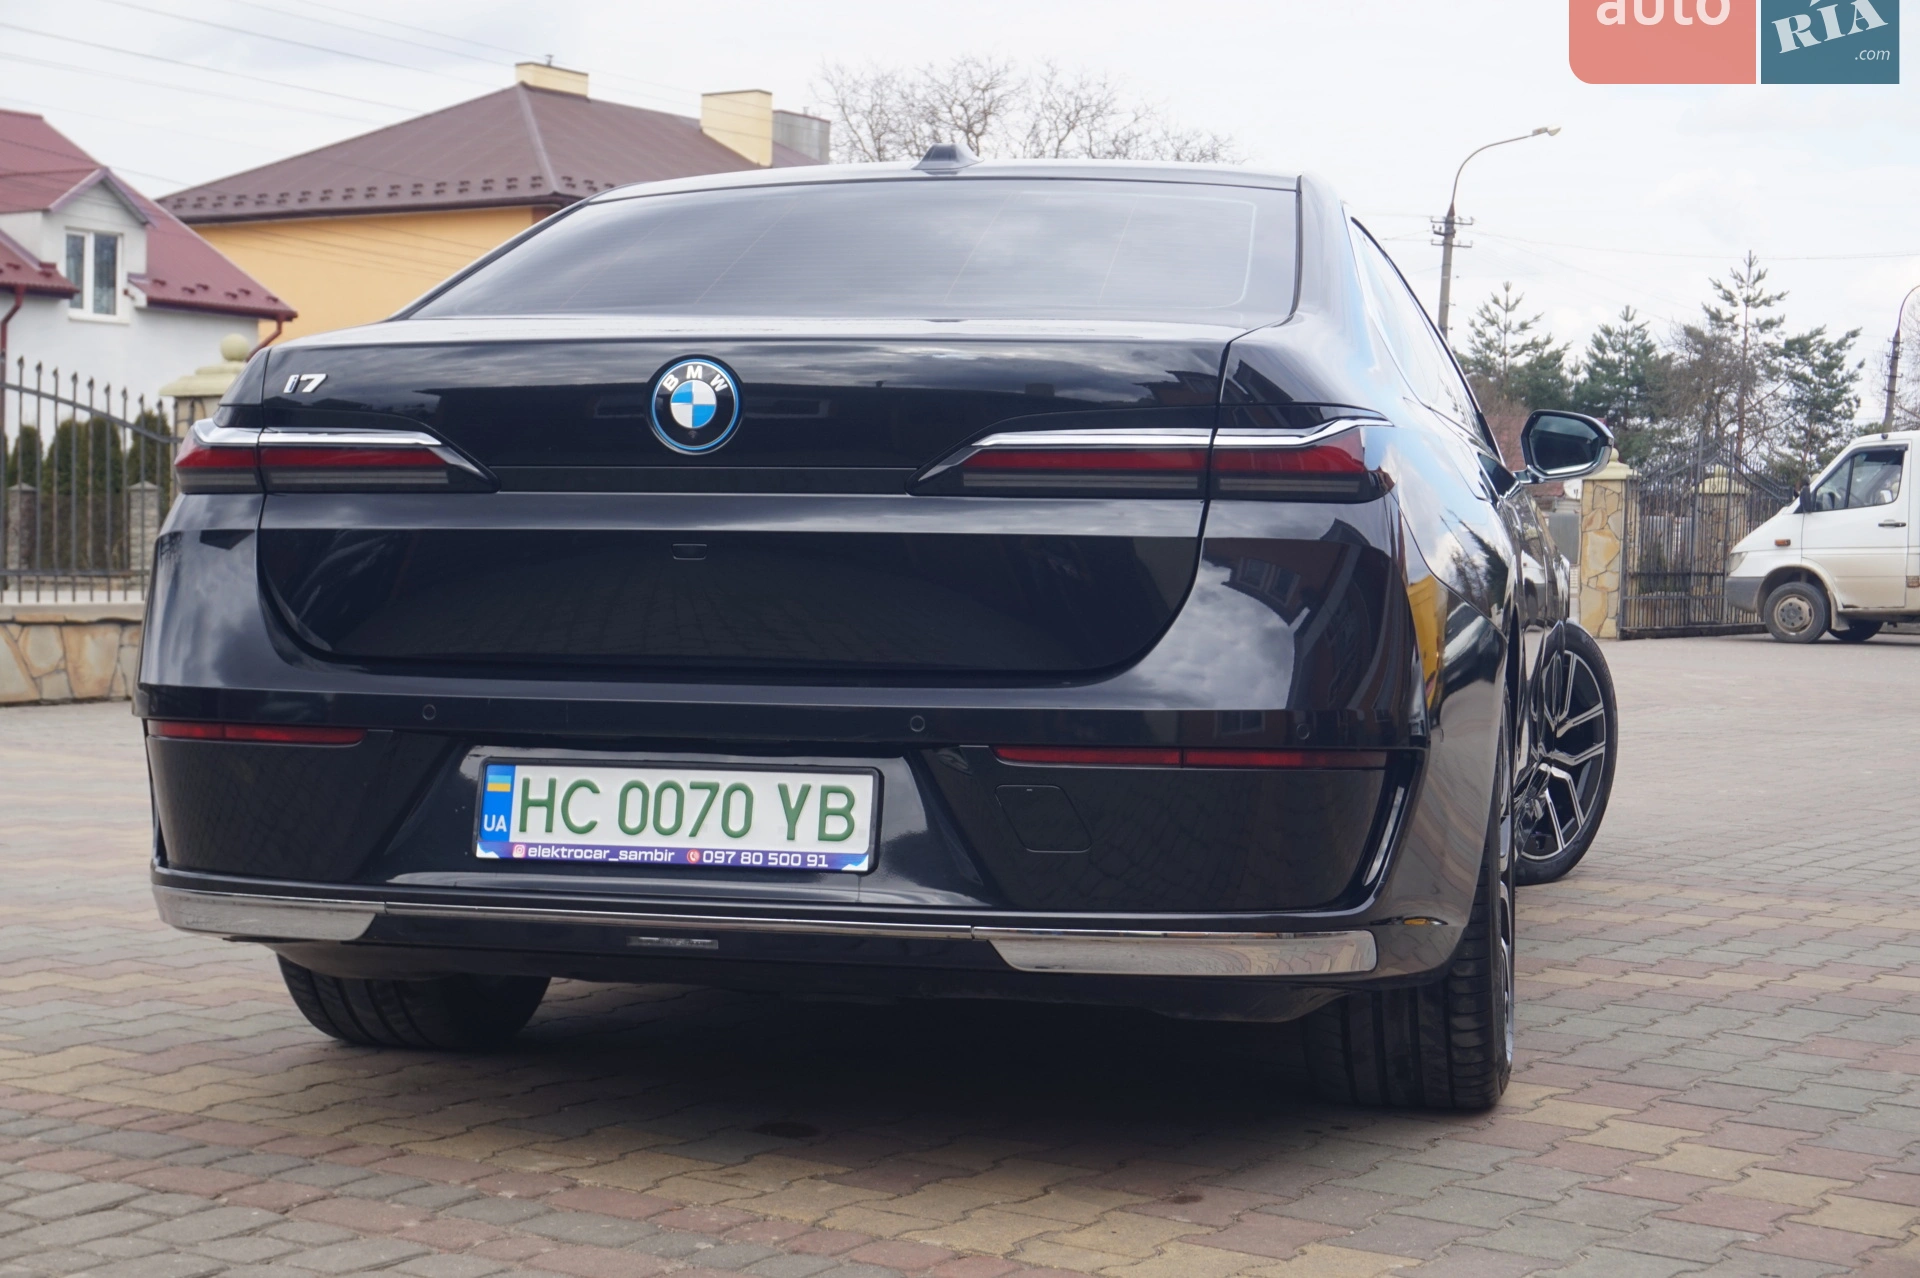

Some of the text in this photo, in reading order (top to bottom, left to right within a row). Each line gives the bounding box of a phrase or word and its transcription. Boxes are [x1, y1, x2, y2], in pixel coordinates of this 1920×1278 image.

[662, 365, 728, 392] BMW
[518, 777, 856, 842] HC 0070 YB
[483, 814, 507, 833] UA
[528, 845, 675, 862] elektrocar_sambir
[702, 850, 829, 867] 097 80 500 91
